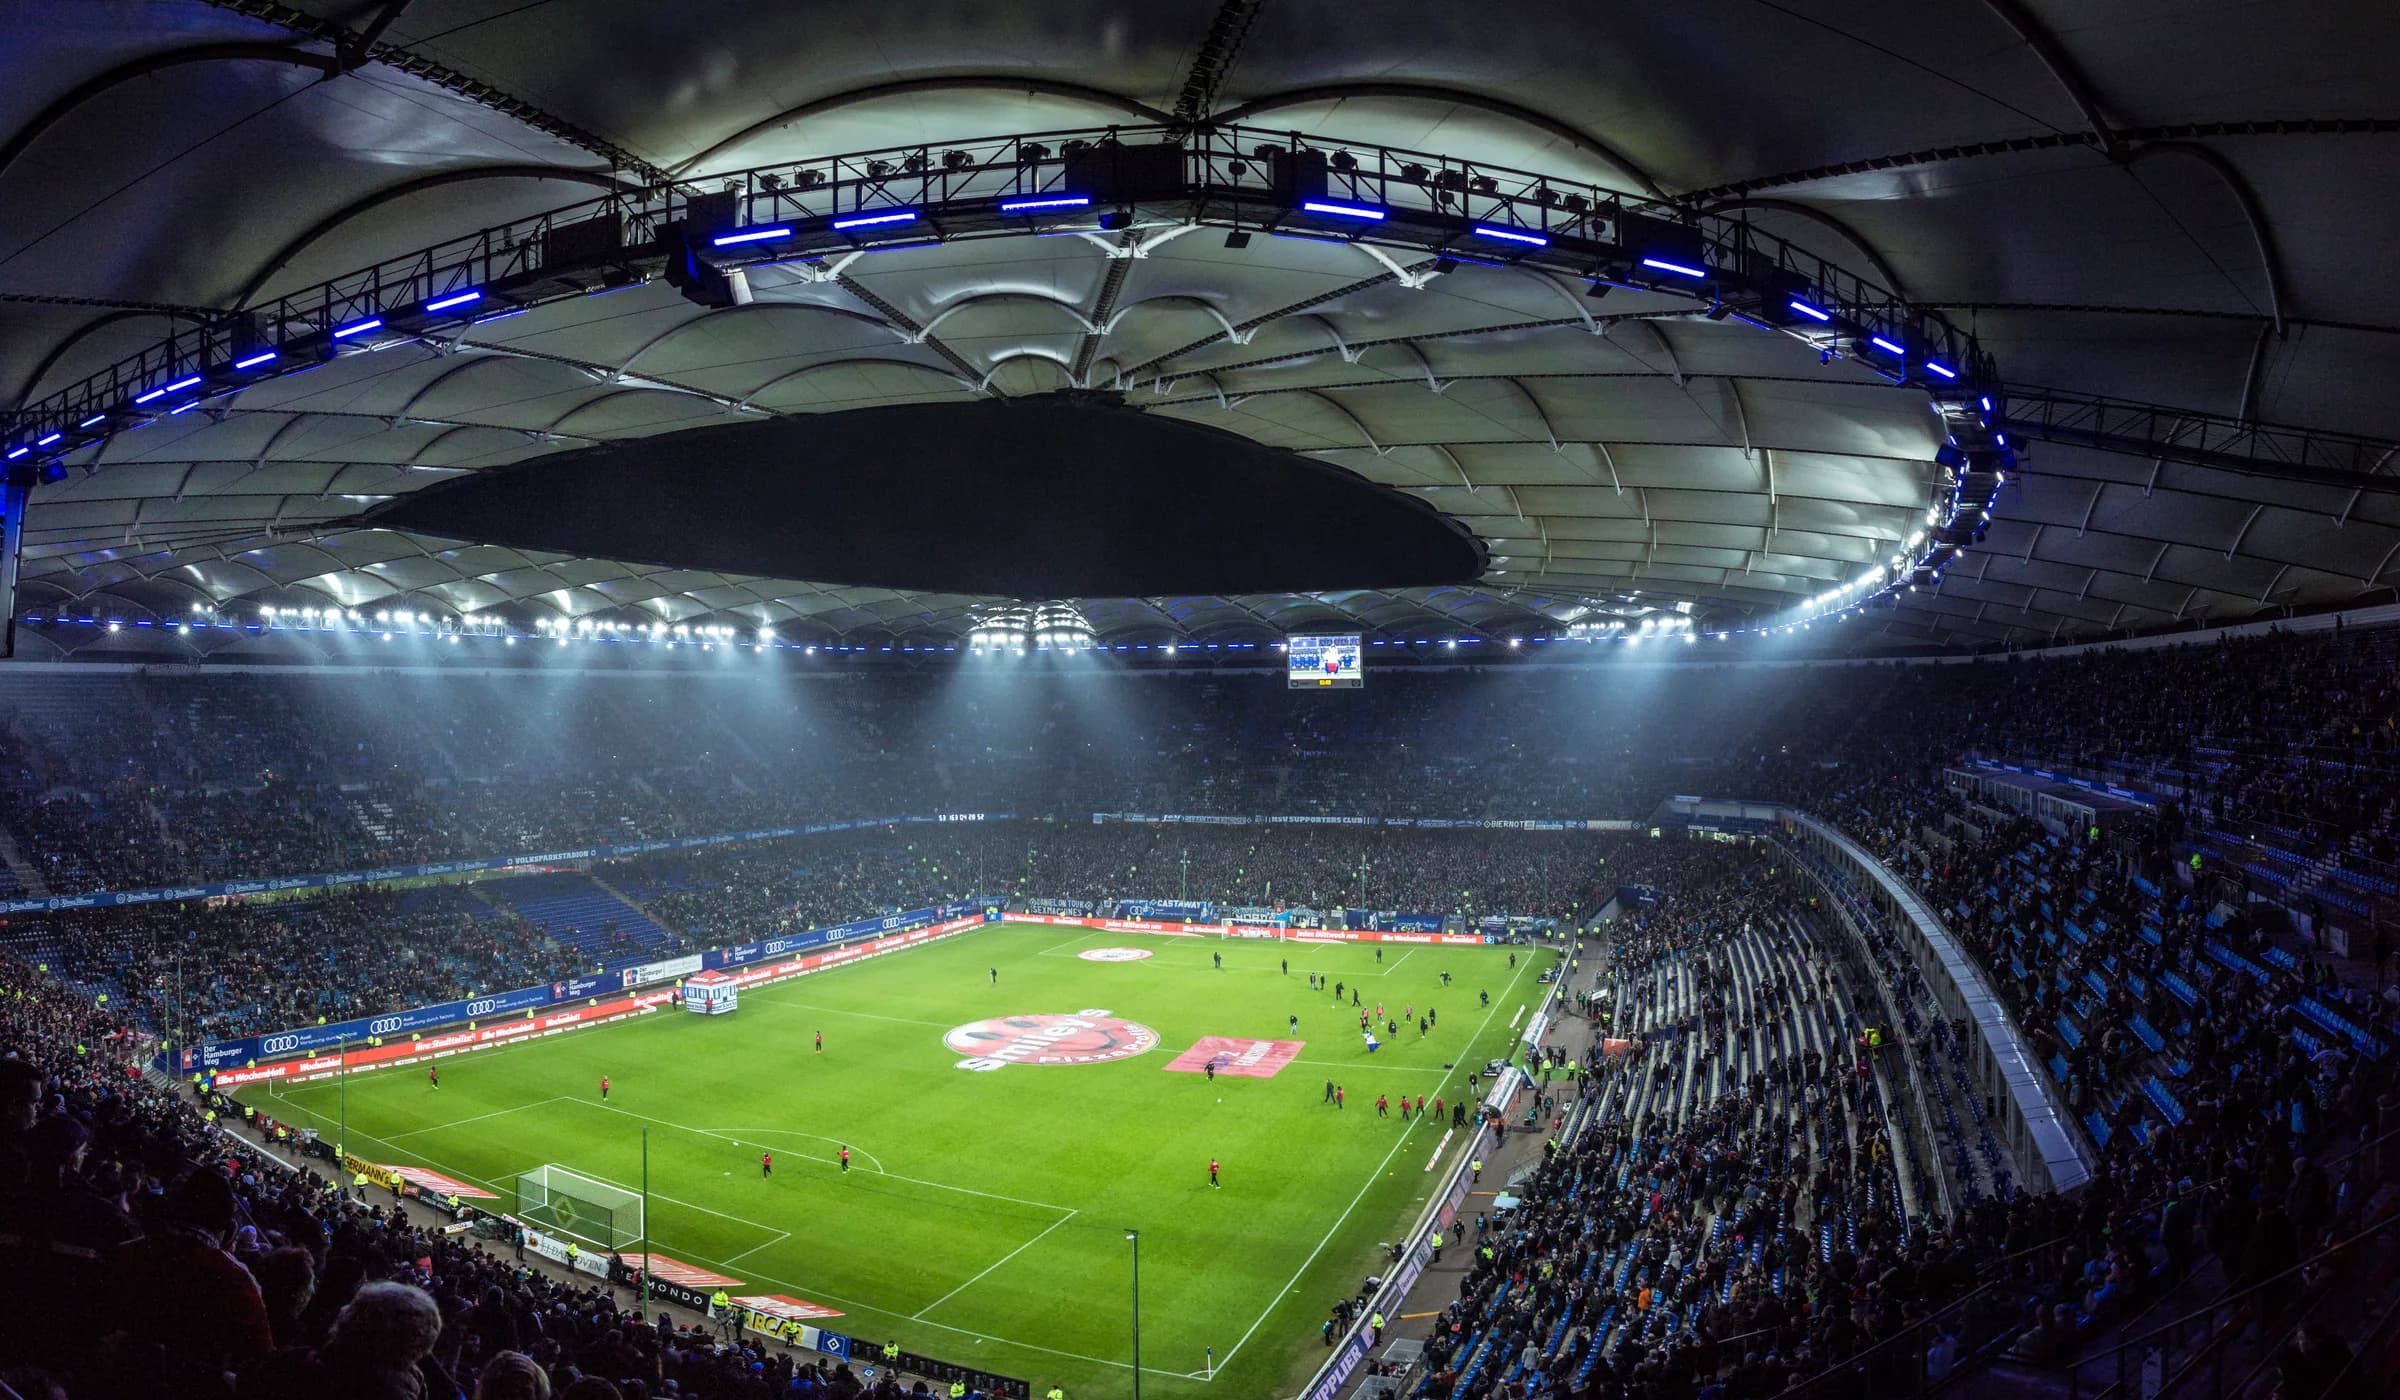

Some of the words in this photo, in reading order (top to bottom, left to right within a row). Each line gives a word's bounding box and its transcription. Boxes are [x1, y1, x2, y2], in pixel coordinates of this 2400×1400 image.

[1289, 816, 1342, 824] SUPPORTERS
[1342, 817, 1363, 825] CLUB
[515, 850, 589, 864] VOLKSPARKSTADION
[204, 1045, 216, 1053] Der
[204, 1047, 242, 1060] Hamburger
[204, 1057, 220, 1066] Weg
[216, 1073, 235, 1086] Elbe
[235, 1066, 287, 1083] Wochenblatt
